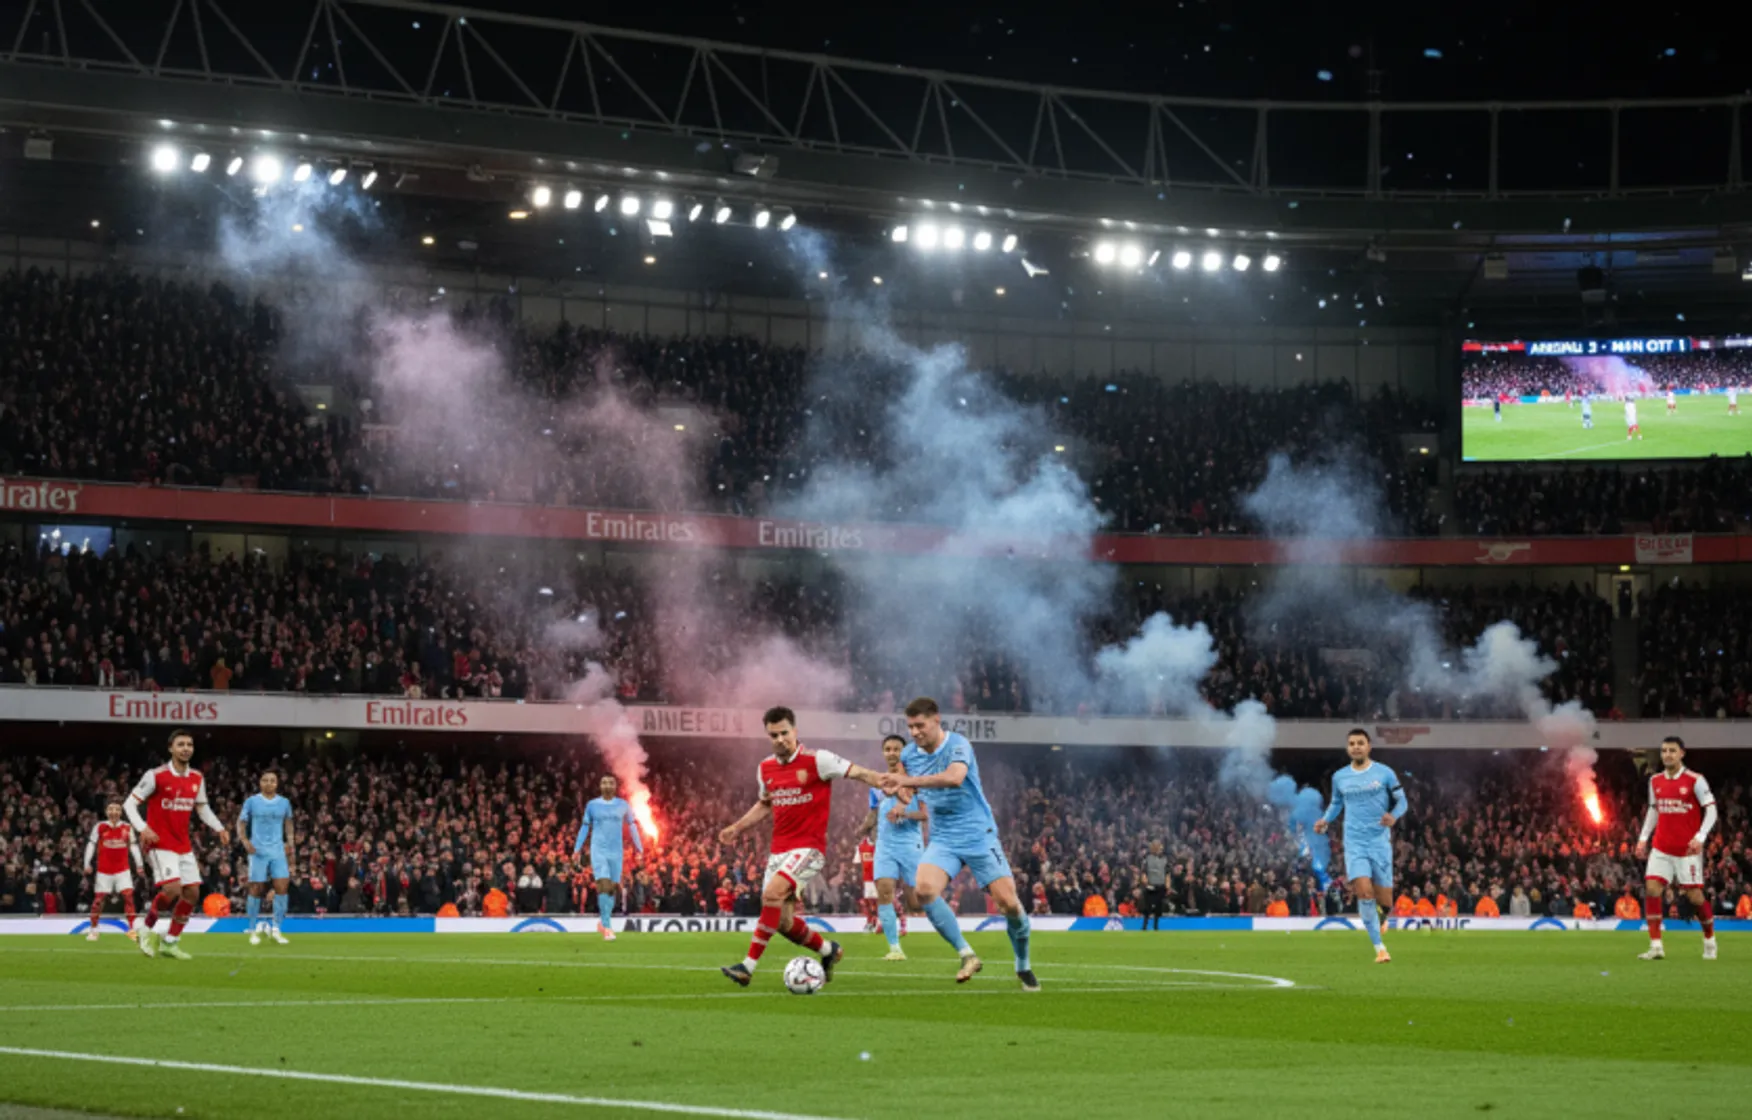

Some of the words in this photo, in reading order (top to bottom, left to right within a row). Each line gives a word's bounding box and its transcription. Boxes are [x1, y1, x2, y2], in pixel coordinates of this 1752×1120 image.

[586, 512, 694, 541] Emirates
[759, 520, 864, 549] Emirates
[109, 693, 218, 720] Emirates
[366, 701, 468, 726] Emirates
